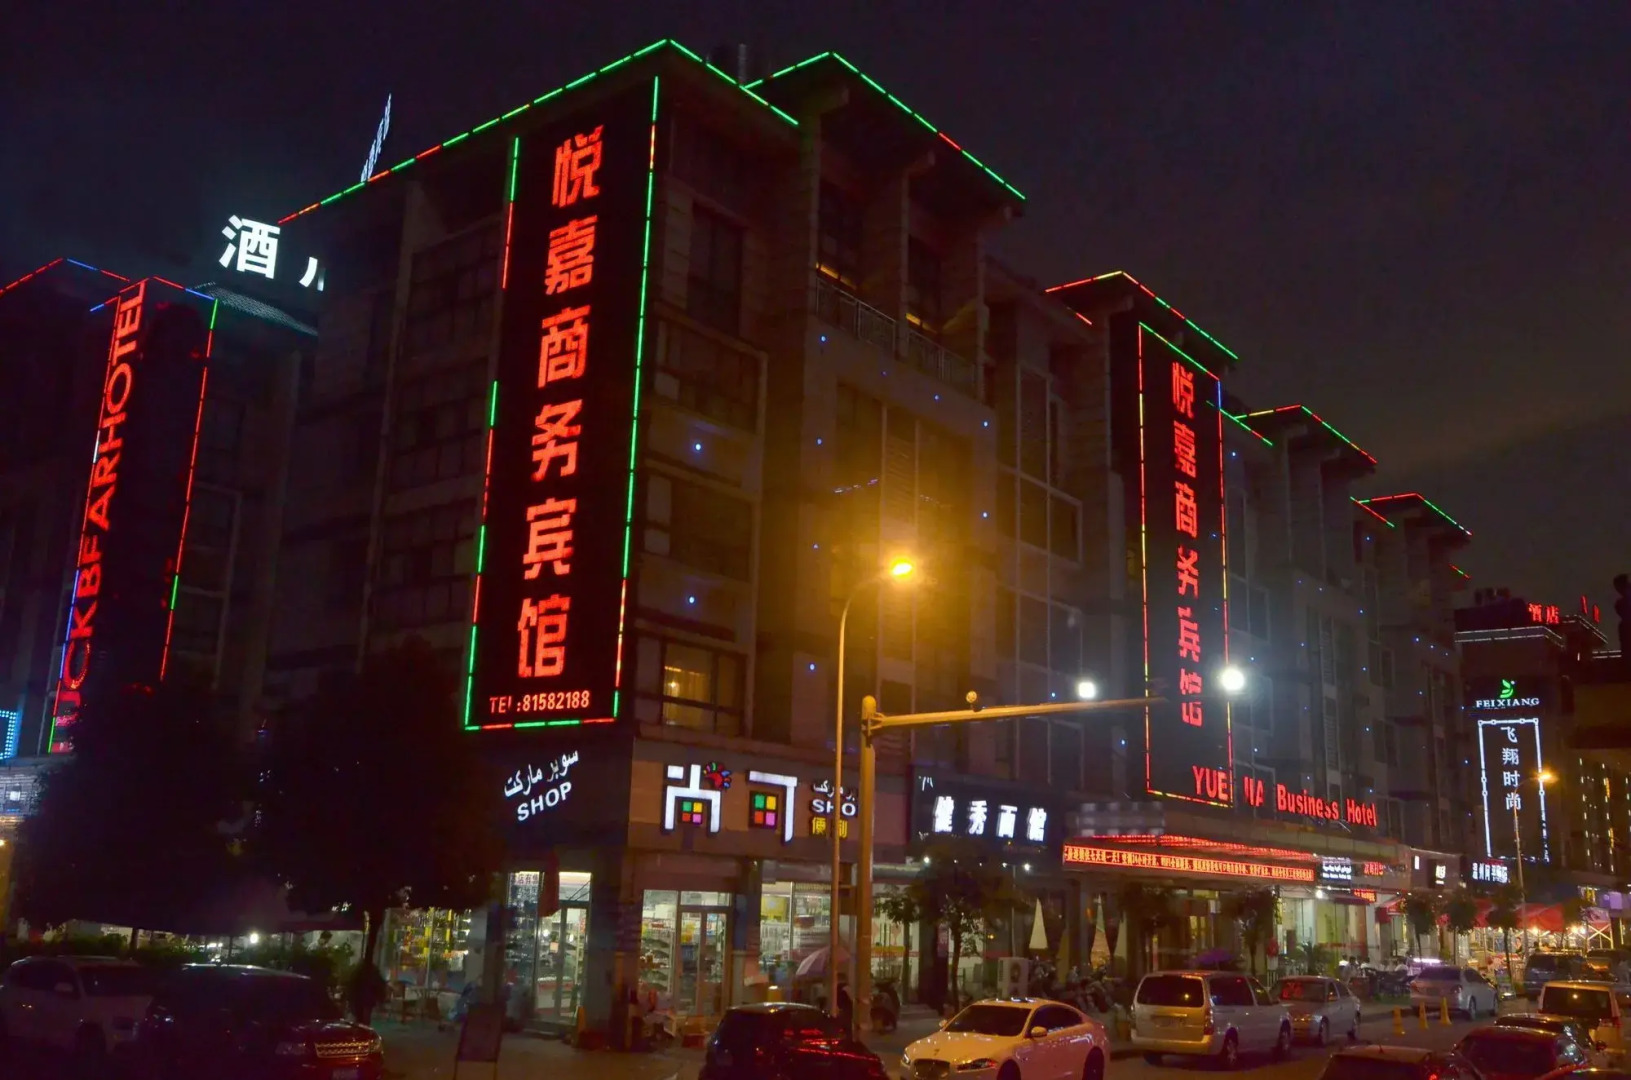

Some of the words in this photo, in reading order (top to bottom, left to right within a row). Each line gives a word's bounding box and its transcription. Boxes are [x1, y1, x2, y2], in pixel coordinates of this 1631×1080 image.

[517, 125, 604, 679] 悦嘉商务宾馆
[1476, 697, 1540, 709] FEIXIANG
[1192, 764, 1229, 801] YUE
[1276, 783, 1340, 820] Business
[1346, 798, 1377, 827] Hotel
[1500, 726, 1522, 811] 飞翔时尚
[517, 781, 572, 821] SHOP
